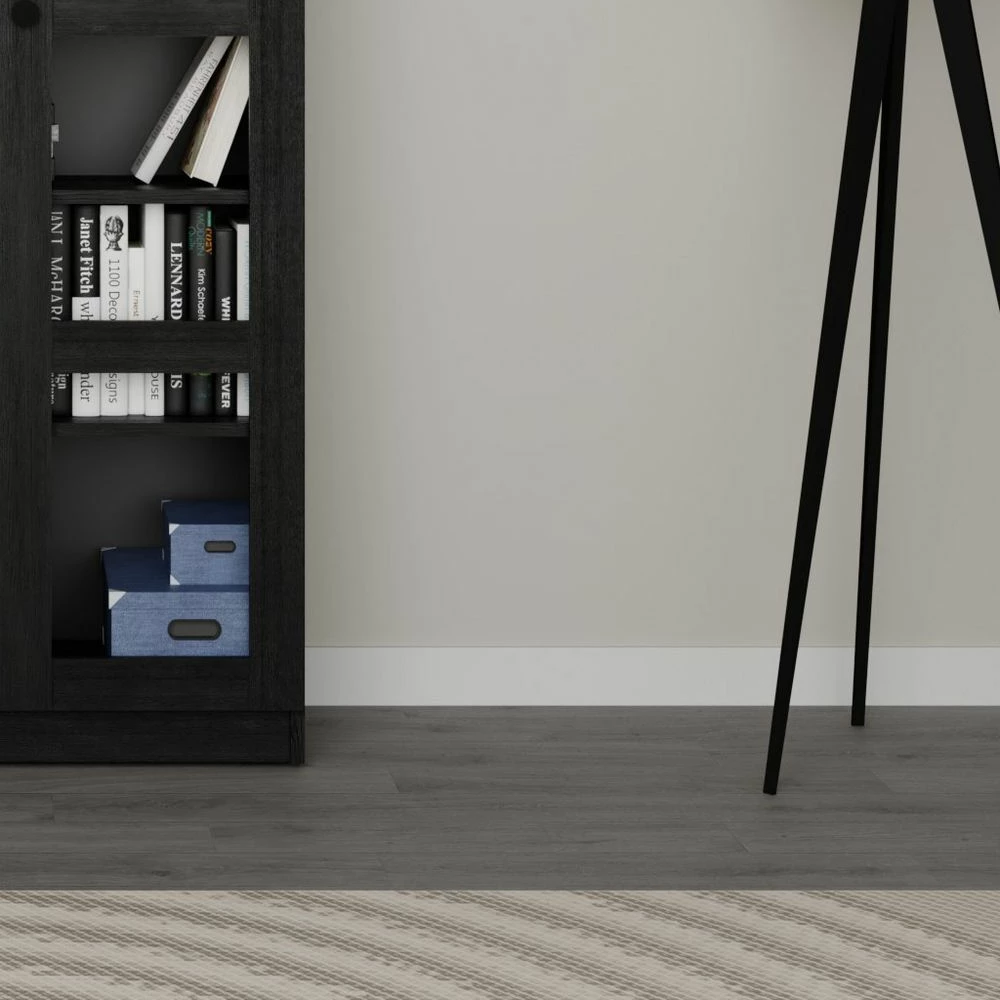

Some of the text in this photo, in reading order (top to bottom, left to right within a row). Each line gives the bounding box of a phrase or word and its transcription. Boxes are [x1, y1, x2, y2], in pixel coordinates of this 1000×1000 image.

[79, 217, 94, 294] Janet Fitch
[108, 259, 121, 287] 1100
[170, 242, 183, 320] LENNARD
[197, 268, 206, 285] Kim
